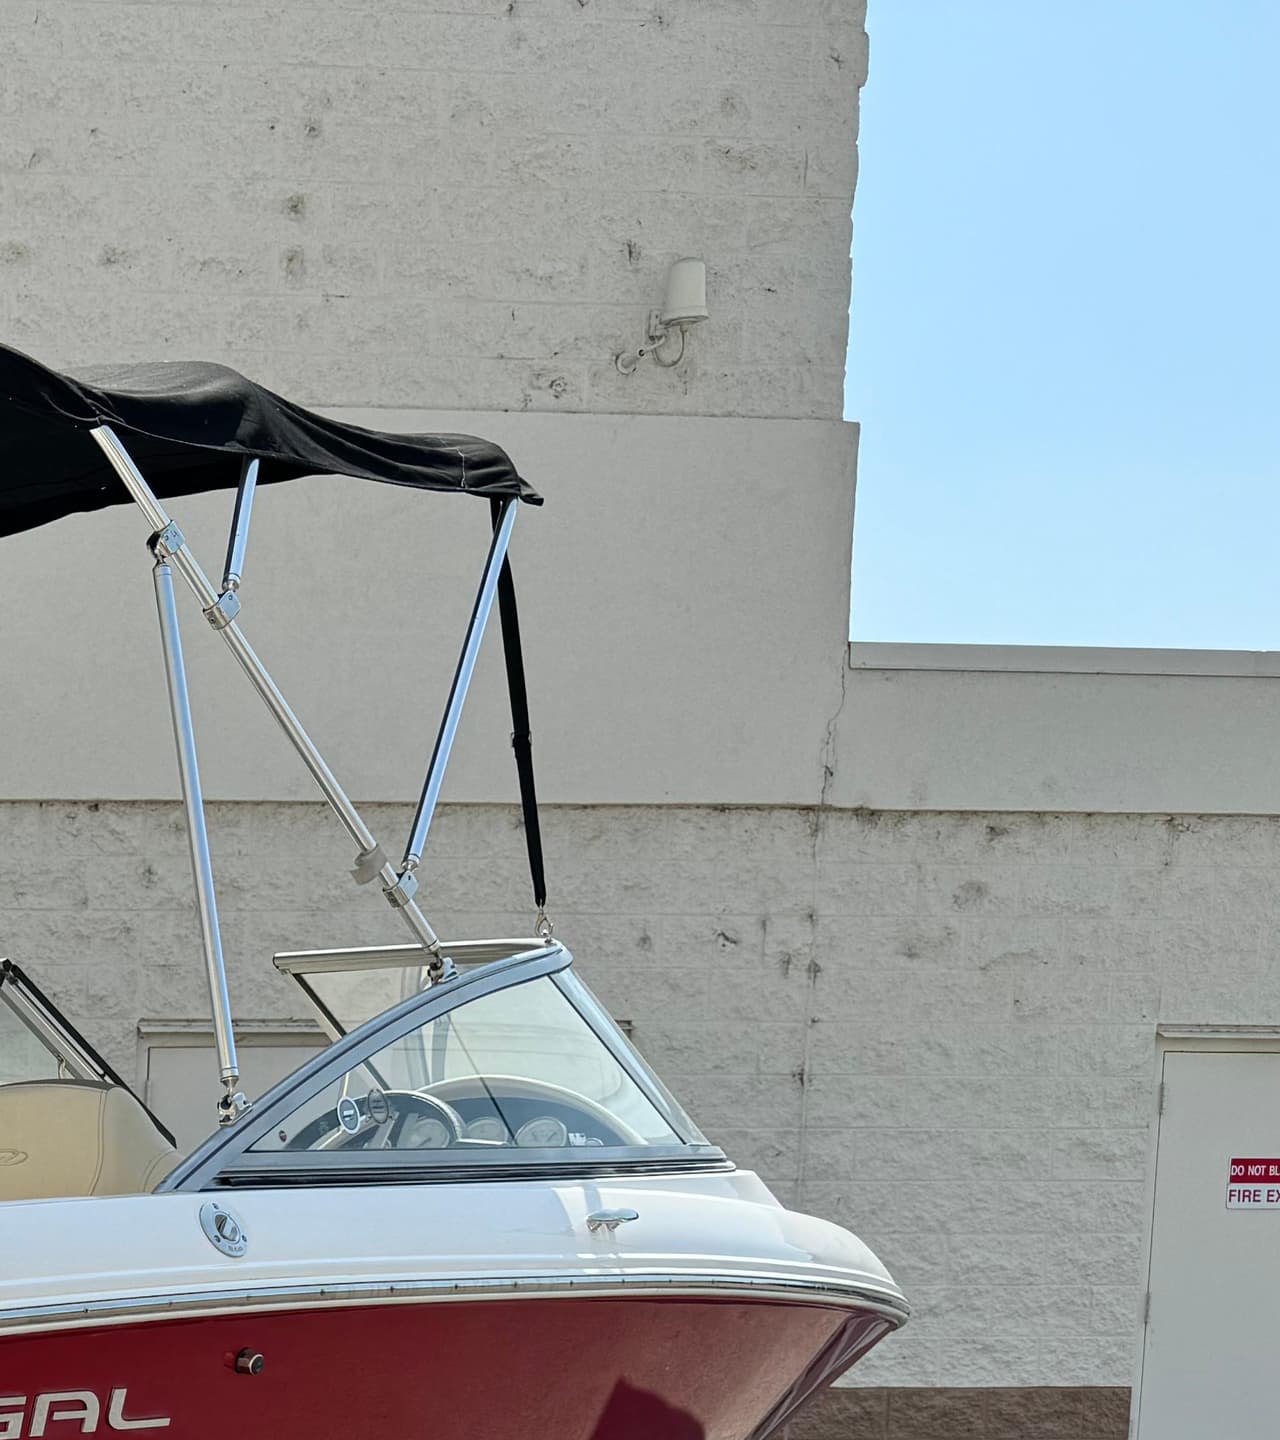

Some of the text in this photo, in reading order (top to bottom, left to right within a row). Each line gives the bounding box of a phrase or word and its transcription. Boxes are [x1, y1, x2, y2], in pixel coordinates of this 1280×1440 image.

[1231, 1165, 1245, 1176] DO
[1248, 1165, 1267, 1176] NOT
[1228, 1189, 1262, 1203] FIRE
